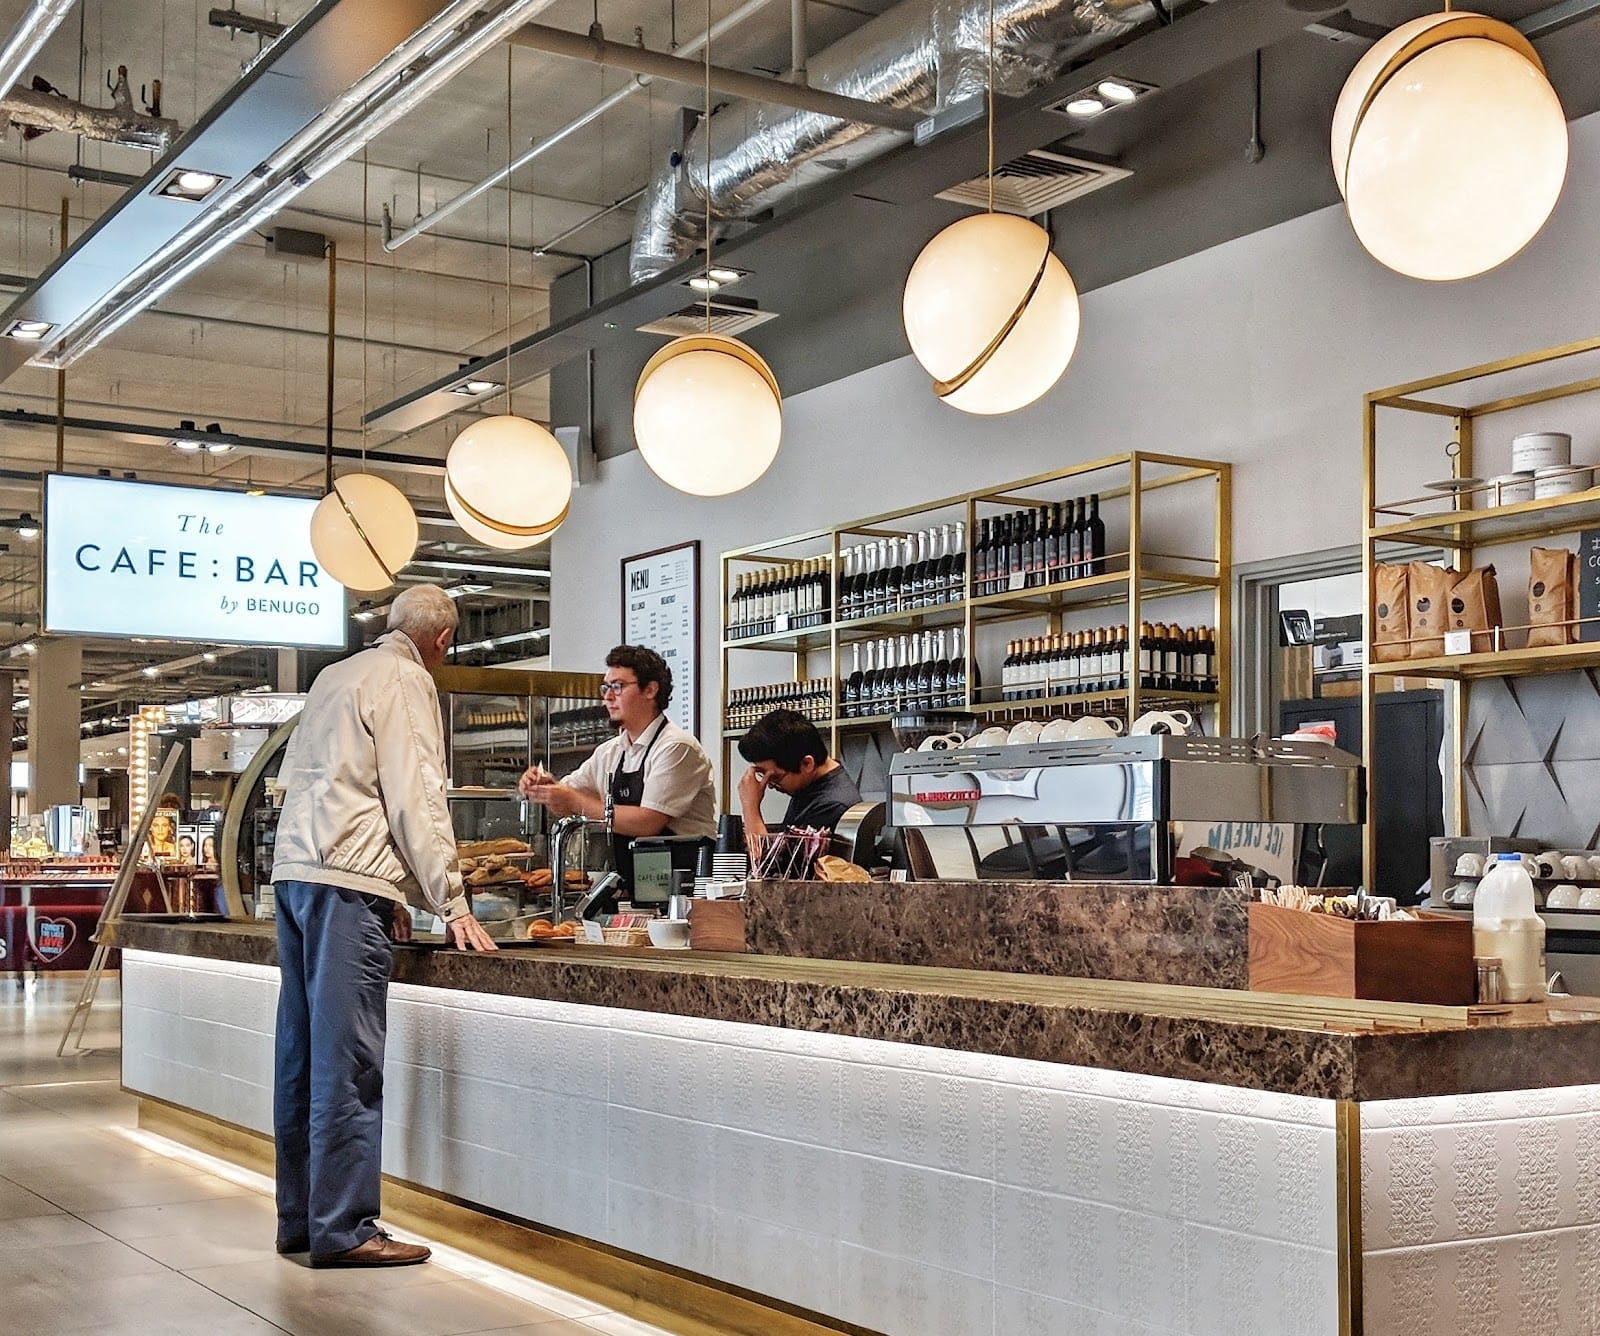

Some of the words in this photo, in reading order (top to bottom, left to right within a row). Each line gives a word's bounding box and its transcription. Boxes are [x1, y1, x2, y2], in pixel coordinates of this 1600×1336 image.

[178, 514, 224, 535] The
[630, 568, 650, 592] MENU
[220, 595, 239, 614] by
[246, 598, 320, 615] BENUGO
